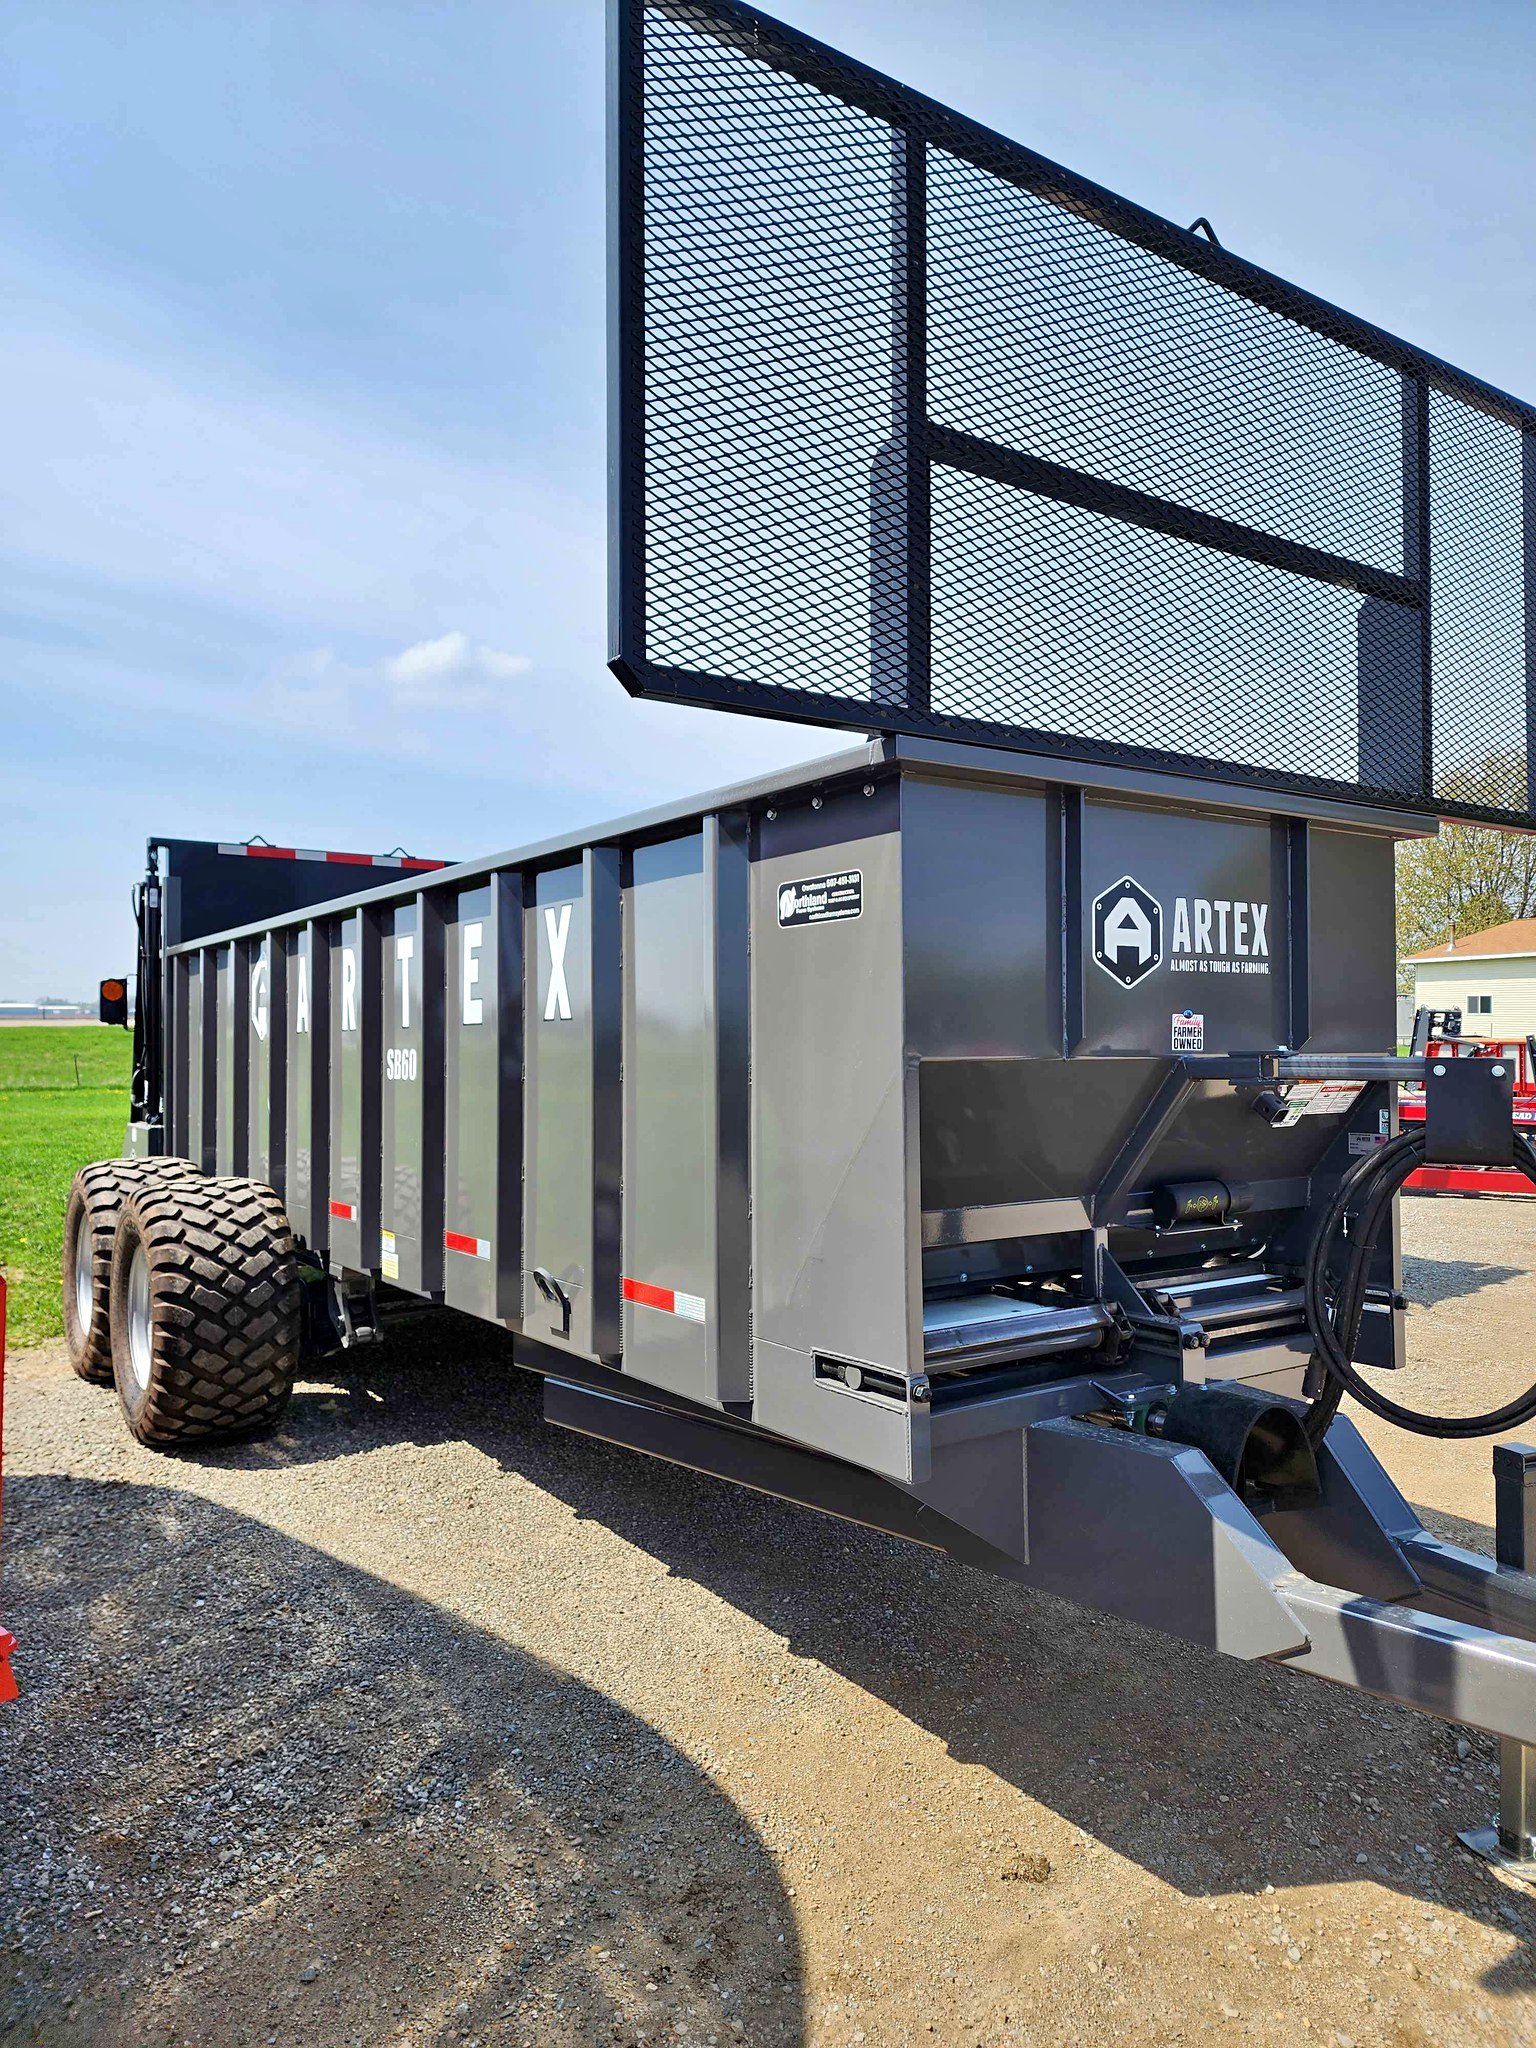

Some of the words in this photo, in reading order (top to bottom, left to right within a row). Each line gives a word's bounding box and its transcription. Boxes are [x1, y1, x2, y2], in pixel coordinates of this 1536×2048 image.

[1171, 897, 1270, 957] ARTEX
[296, 902, 573, 1034] ARTEX
[1170, 959, 1198, 972] ALMOST
[1199, 960, 1208, 972] AS
[1209, 960, 1231, 973] TOUGH
[1231, 961, 1240, 973] AS
[1174, 1015, 1201, 1027] Family
[1173, 1026, 1202, 1037] FARMER
[1173, 1037, 1202, 1050] OWNED
[385, 1048, 418, 1081] SB60
